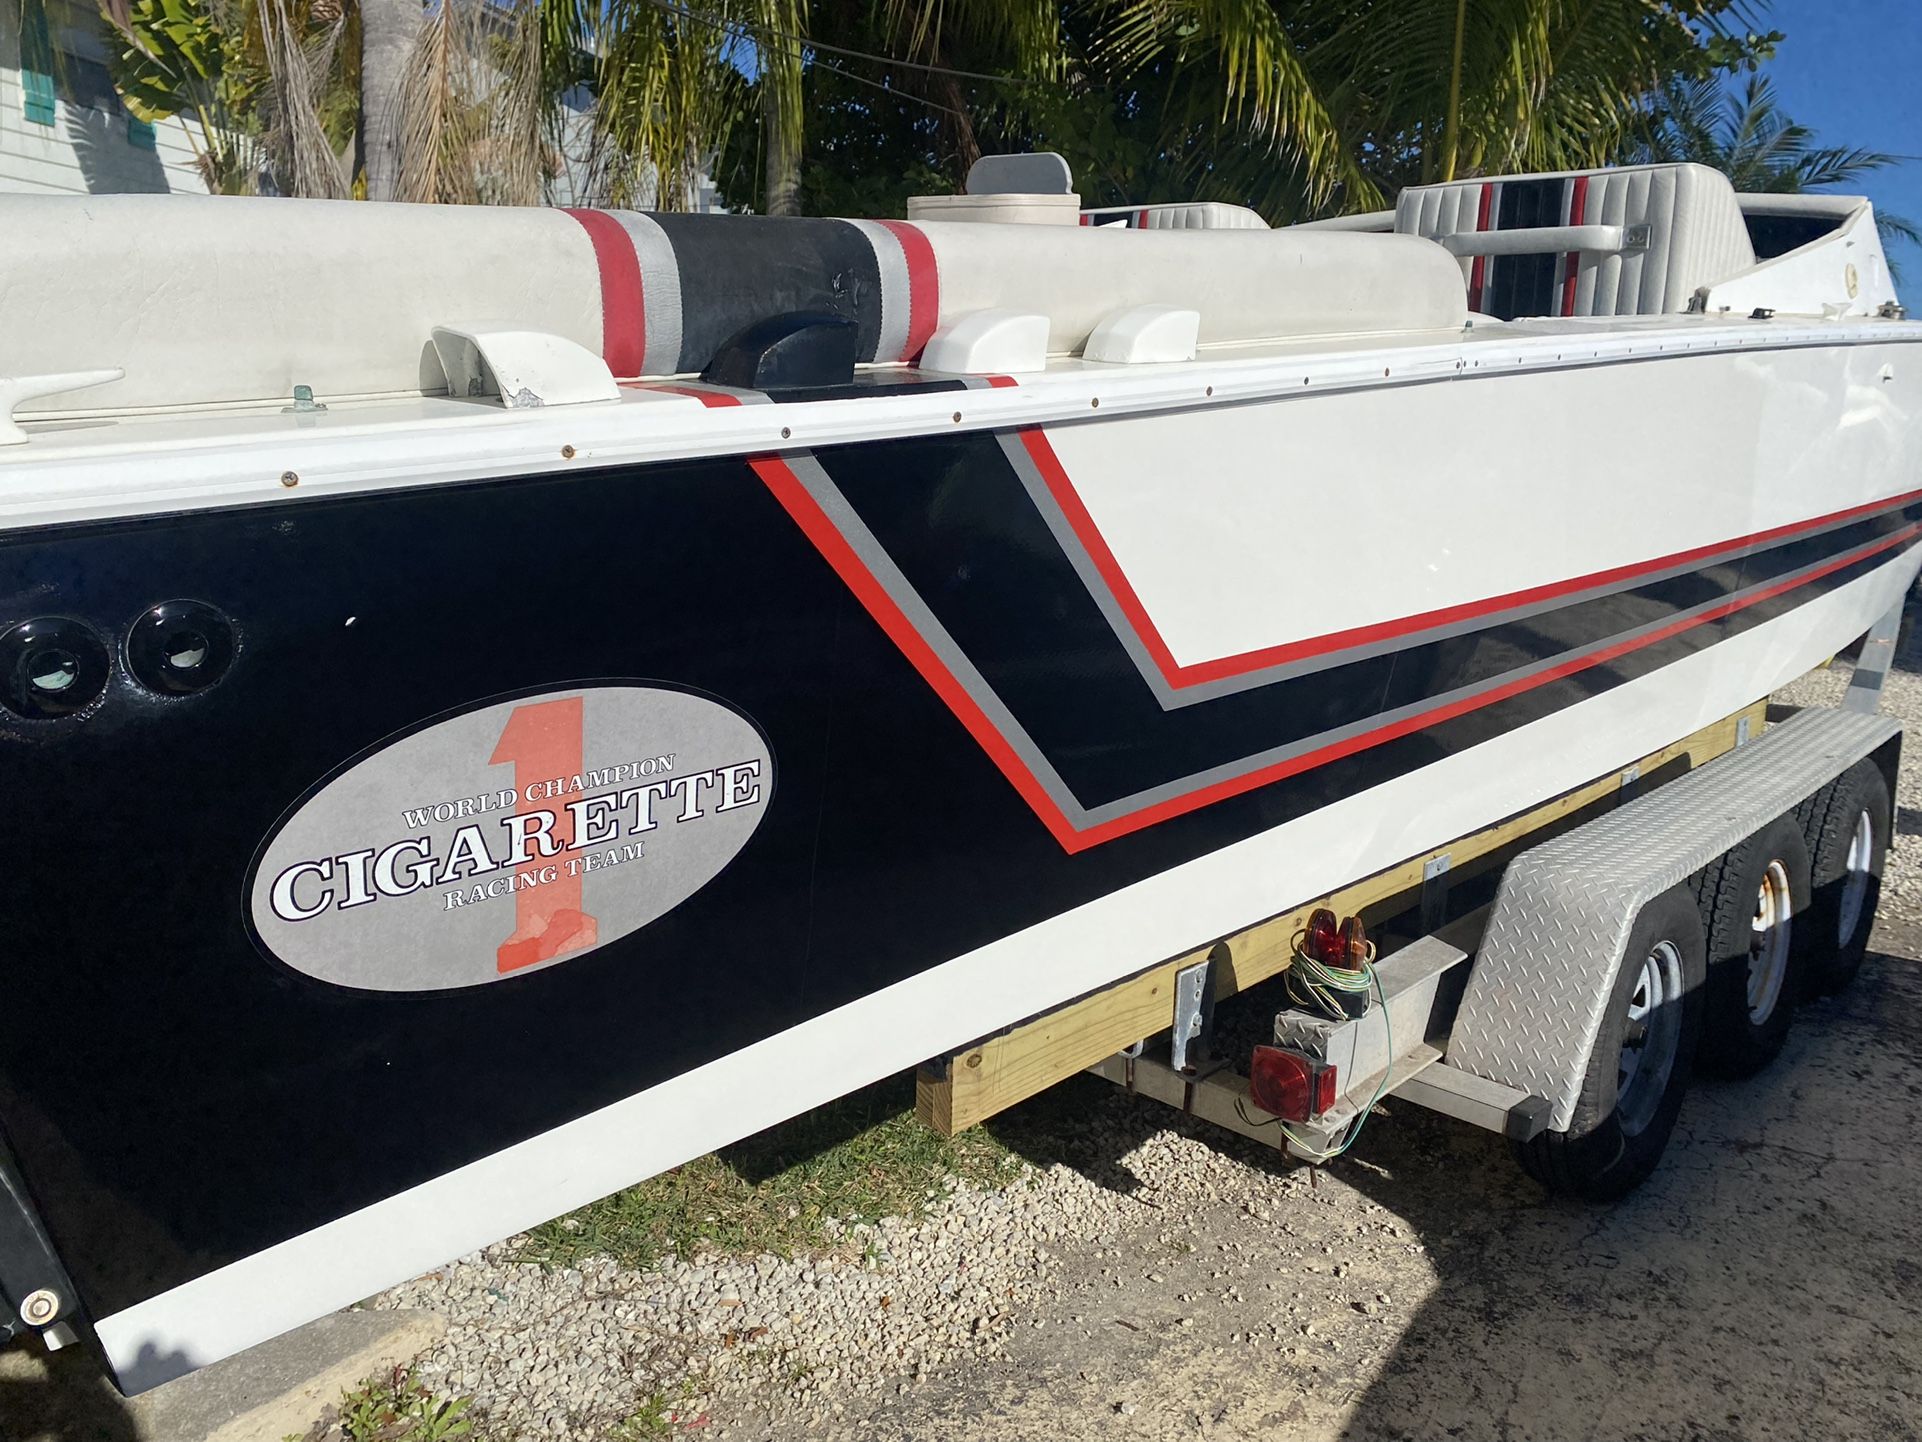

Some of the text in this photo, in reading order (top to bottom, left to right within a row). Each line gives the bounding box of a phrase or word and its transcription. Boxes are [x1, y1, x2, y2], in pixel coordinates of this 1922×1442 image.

[270, 759, 761, 922] CIGARETTE
[402, 753, 675, 829] WORLD CHAMPION
[487, 696, 597, 974] 1
[444, 841, 645, 911] RACING TEAM
